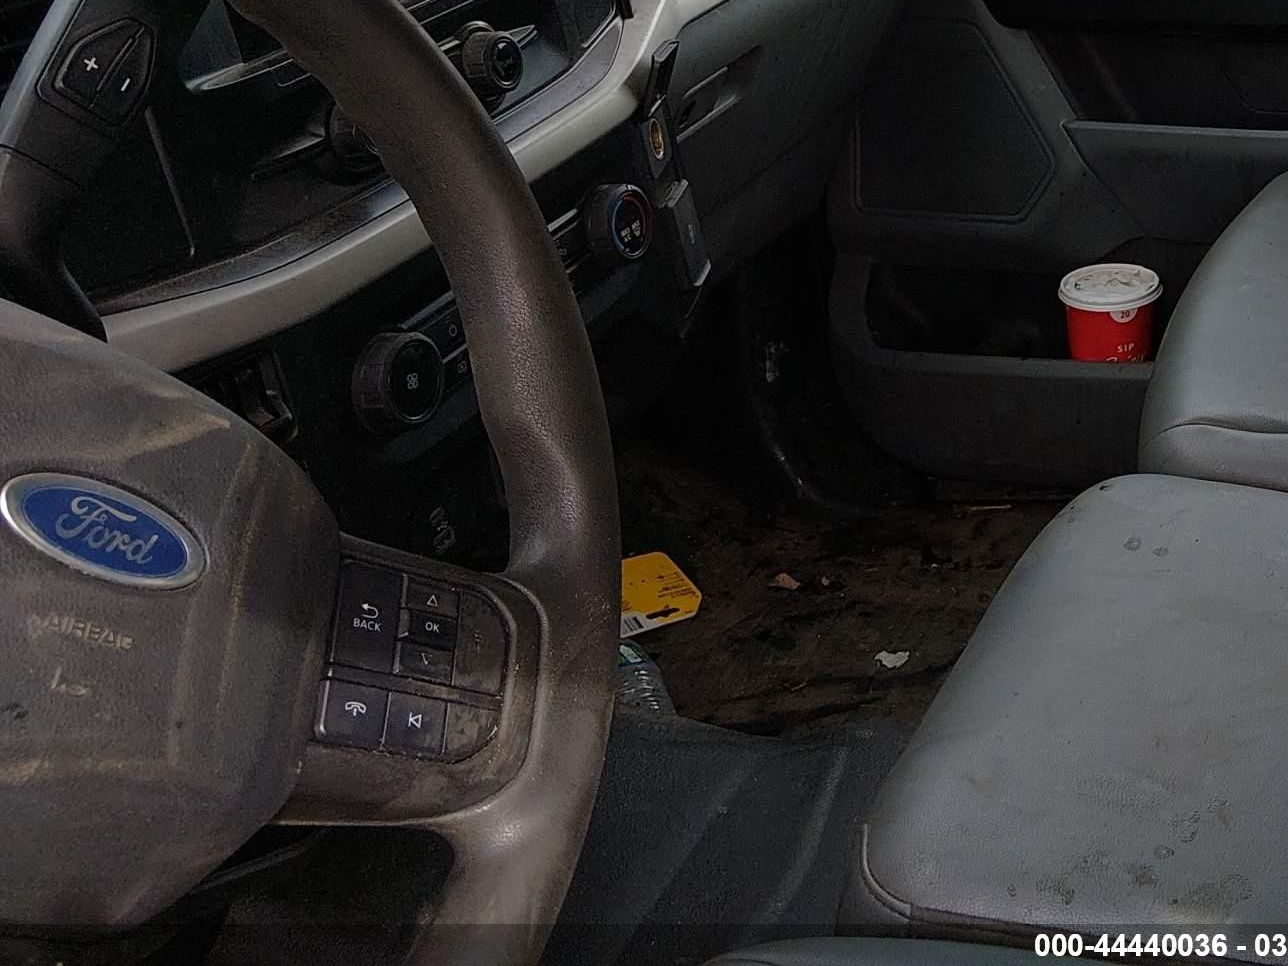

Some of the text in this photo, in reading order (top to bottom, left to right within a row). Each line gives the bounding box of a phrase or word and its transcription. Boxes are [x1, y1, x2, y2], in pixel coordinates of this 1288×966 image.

[1117, 343, 1134, 353] SIP
[55, 496, 159, 564] Ford
[353, 618, 382, 633] BACK
[425, 621, 440, 634] OK
